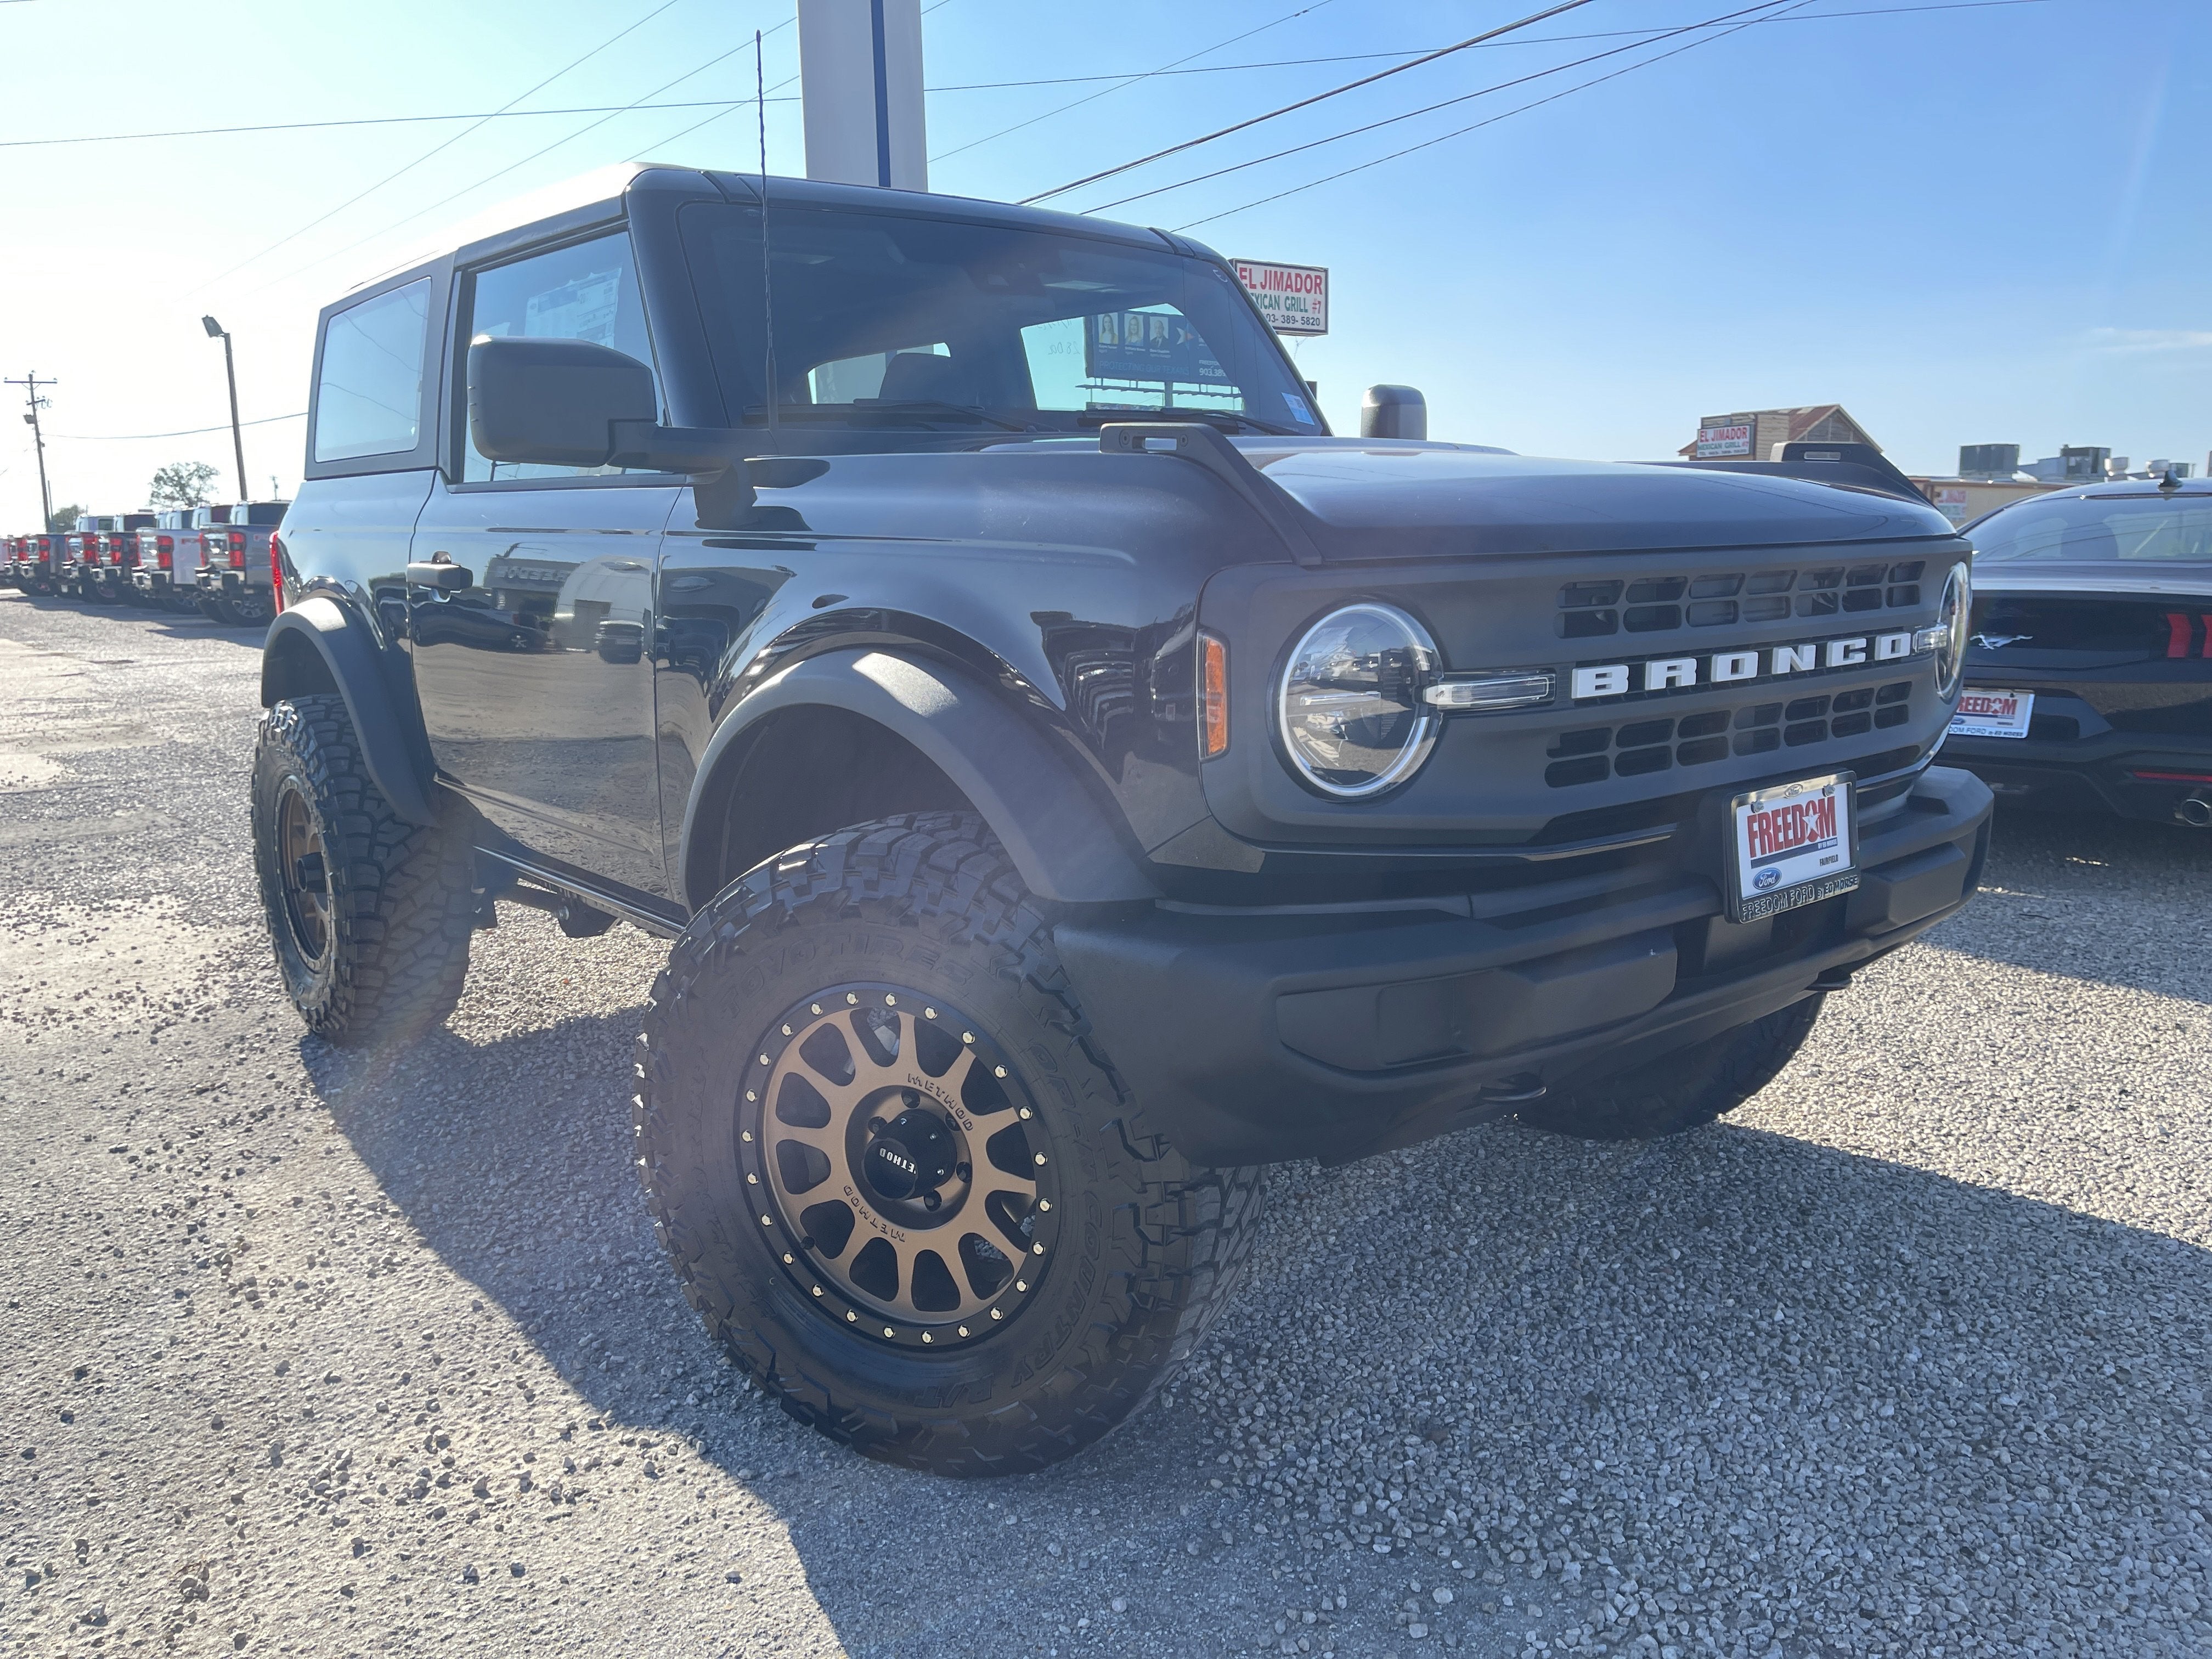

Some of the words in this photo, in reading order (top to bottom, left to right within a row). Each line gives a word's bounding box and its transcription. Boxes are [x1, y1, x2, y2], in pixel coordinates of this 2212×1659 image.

[1239, 267, 1256, 289] EL
[1260, 269, 1322, 295] JIMADOR
[1284, 296, 1308, 313] GRILL
[1312, 298, 1322, 314] #7
[1301, 316, 1321, 326] 5820
[1700, 430, 1709, 442] EL
[1711, 427, 1747, 441] JIMADOR
[1571, 632, 1911, 699] BRONCO
[1959, 696, 2017, 715] REEDOM
[1747, 796, 1837, 858] FREEDOM
[1819, 854, 1838, 867] FAIRFIELD
[1759, 872, 1776, 887] Ford
[1742, 892, 1788, 921] FREEDOM
[1790, 885, 1815, 906] FORD
[1825, 882, 1834, 896] ED
[1835, 874, 1858, 893] MORSE
[907, 1073, 973, 1131] METHOD
[879, 1148, 916, 1174] ETHOD
[844, 1185, 905, 1242] METHOD
